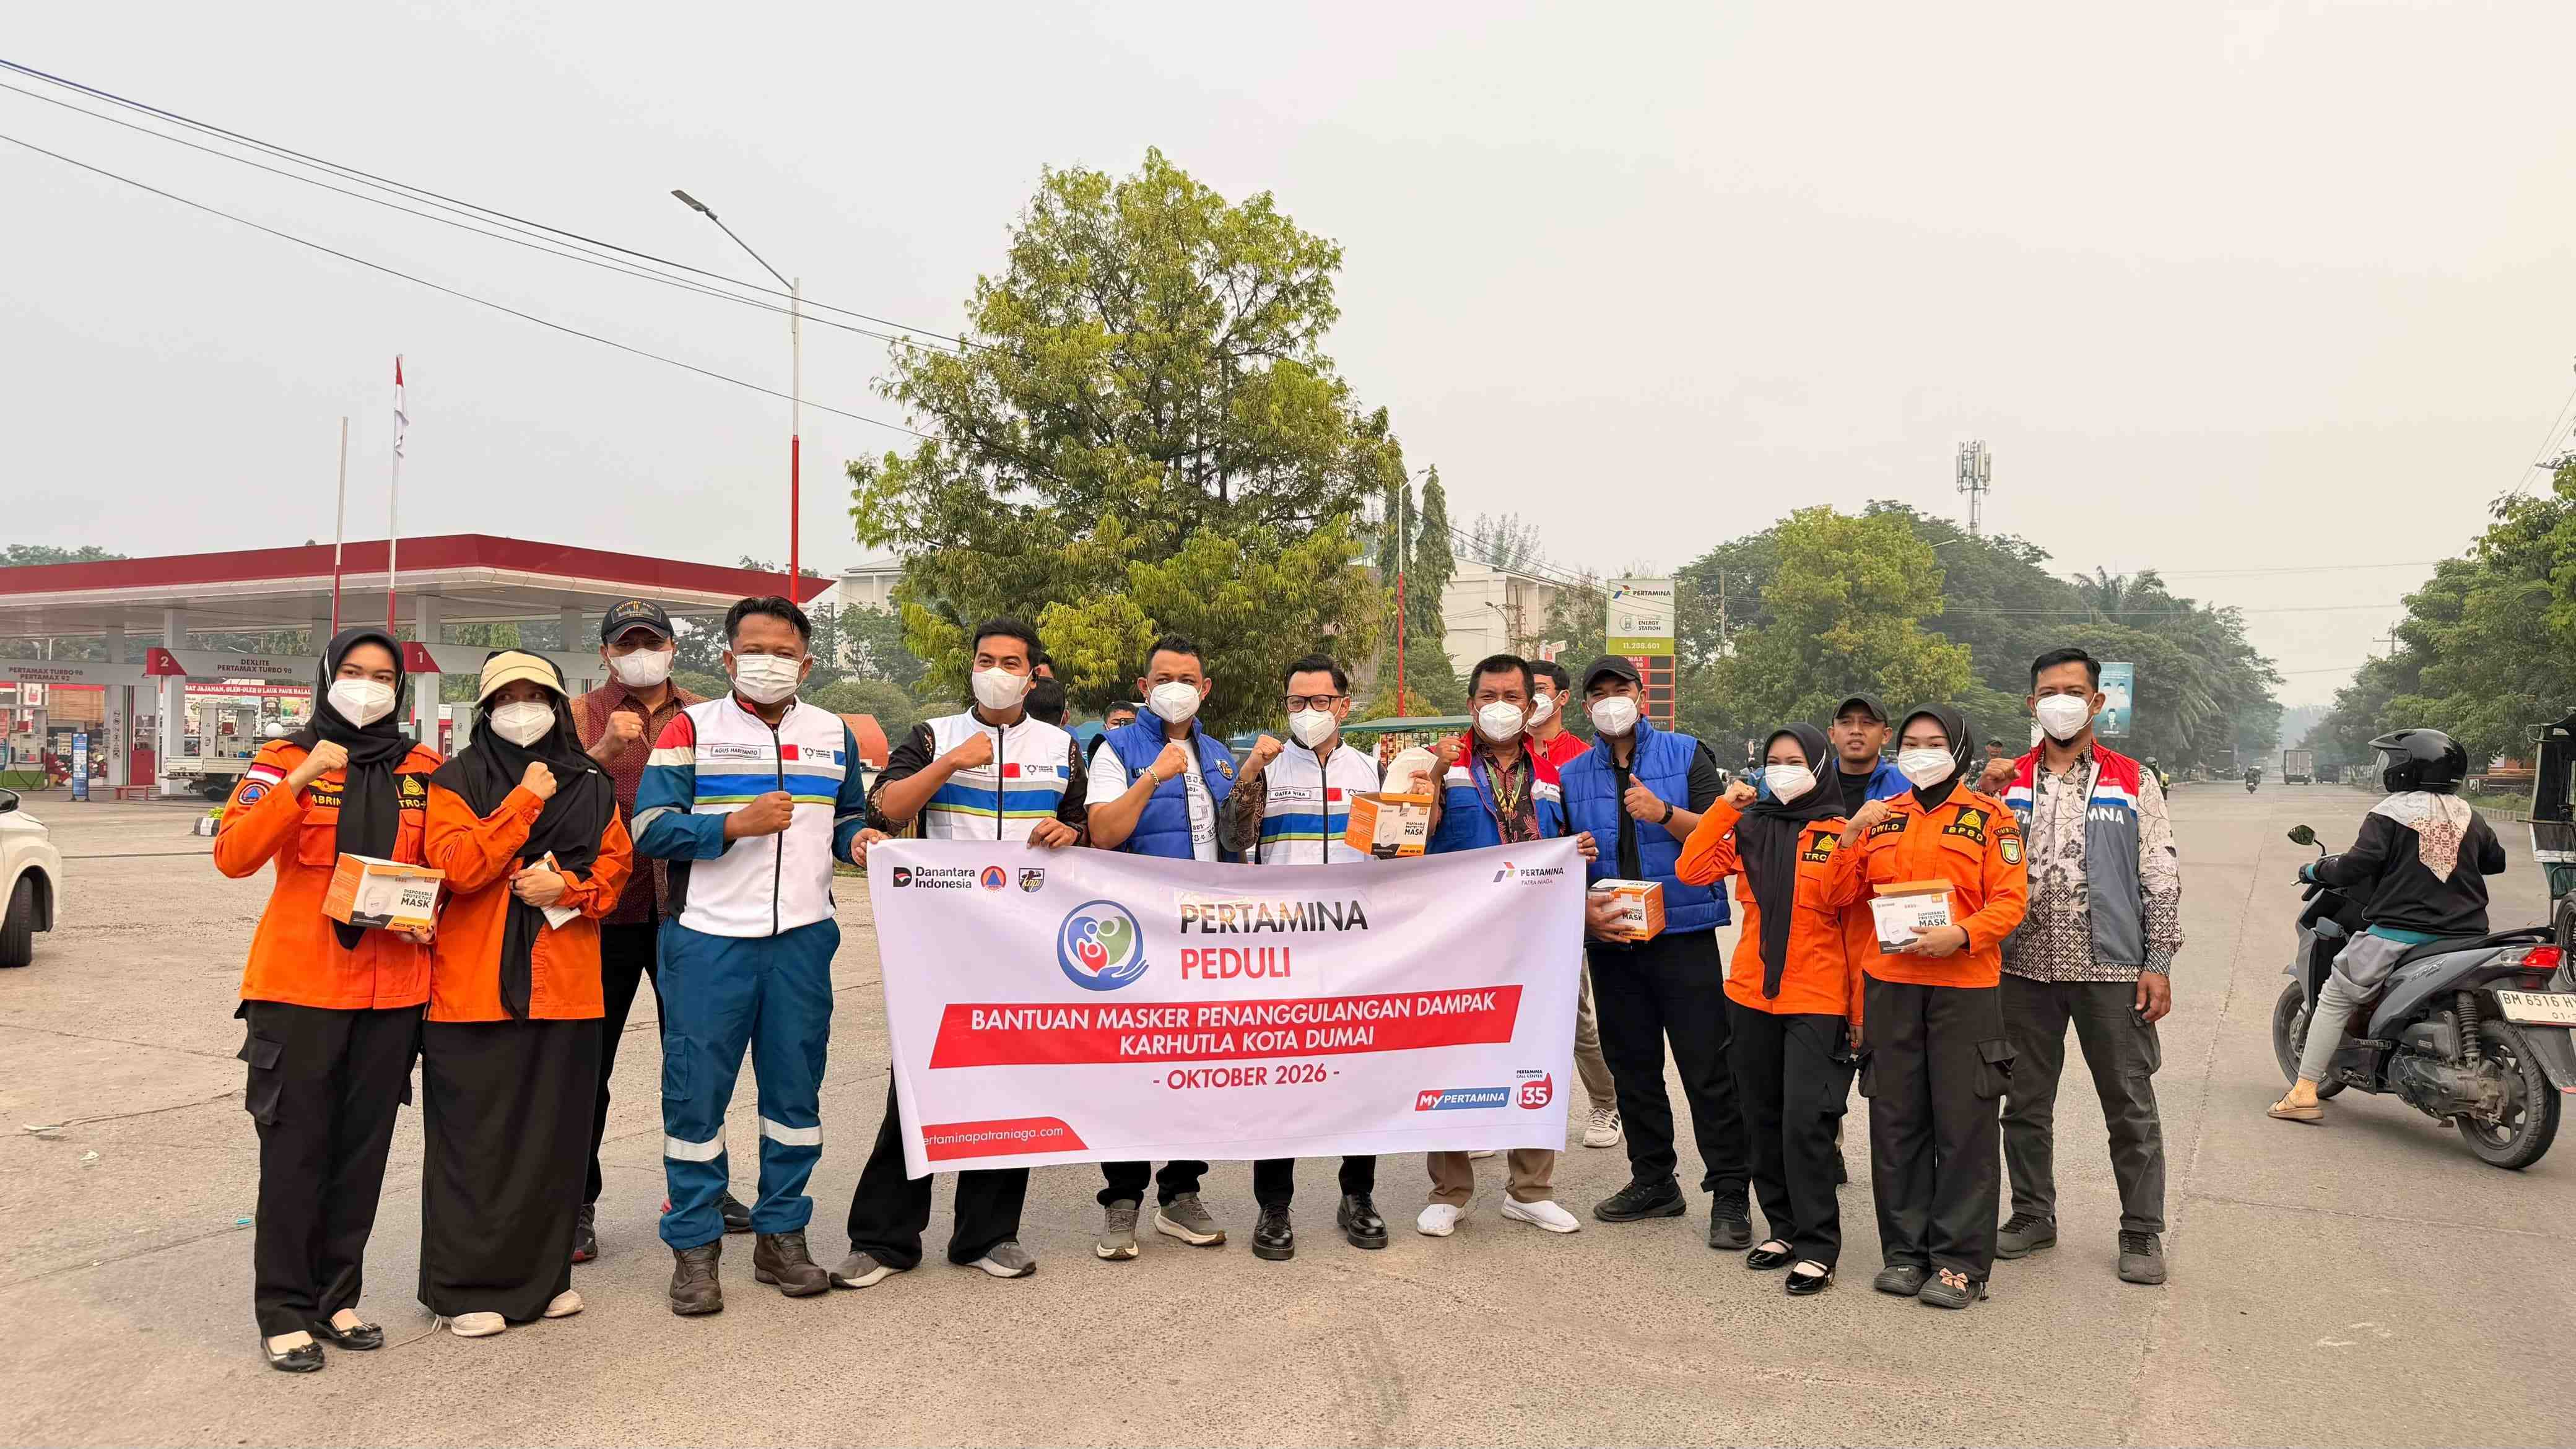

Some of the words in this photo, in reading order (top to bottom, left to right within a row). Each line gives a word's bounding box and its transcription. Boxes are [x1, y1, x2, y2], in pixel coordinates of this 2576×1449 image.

[160, 656, 168, 667] 2
[417, 652, 424, 663] 1
[217, 664, 256, 672] PERTAMAX
[1948, 827, 1983, 842] BPBD
[915, 866, 975, 877] Danantara
[1520, 867, 1564, 876] PERTAMINA
[915, 878, 972, 889] Indonesia
[401, 897, 430, 908] MASK
[1180, 900, 1368, 934] PERTAMINA
[1919, 918, 1947, 926] MASK
[1181, 947, 1290, 980] PEDULI
[2502, 993, 2522, 1005] BM
[2525, 994, 2559, 1007] 6516
[972, 1009, 1089, 1030] BANTUAN
[1096, 1007, 1189, 1029] MASKER
[1197, 999, 1411, 1027] PENANGGULANGAN
[1416, 992, 1496, 1016] DAMPAK
[1120, 1033, 1236, 1056] KARHUTLA
[1242, 1030, 1299, 1051] KOTA
[1305, 1026, 1374, 1048] DUMAI
[1167, 1066, 1268, 1089] OKTOBER
[1275, 1063, 1327, 1085] 2026
[1518, 1087, 1547, 1105] 135
